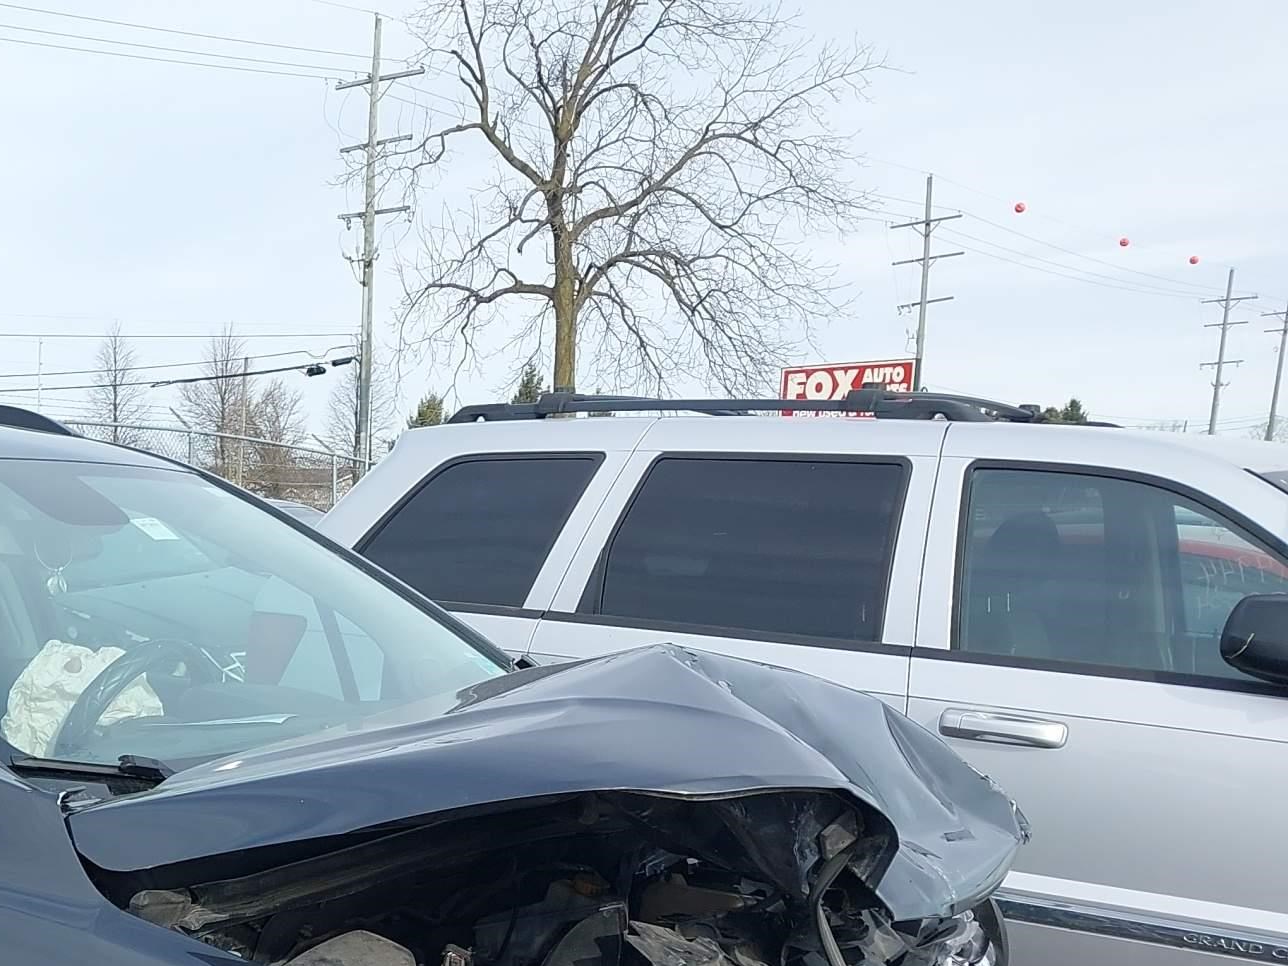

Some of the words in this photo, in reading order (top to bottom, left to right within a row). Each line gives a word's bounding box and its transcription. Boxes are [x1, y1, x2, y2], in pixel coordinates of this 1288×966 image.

[787, 369, 859, 400] FOX
[862, 366, 905, 383] AUTO
[1183, 933, 1264, 954] GRAND
